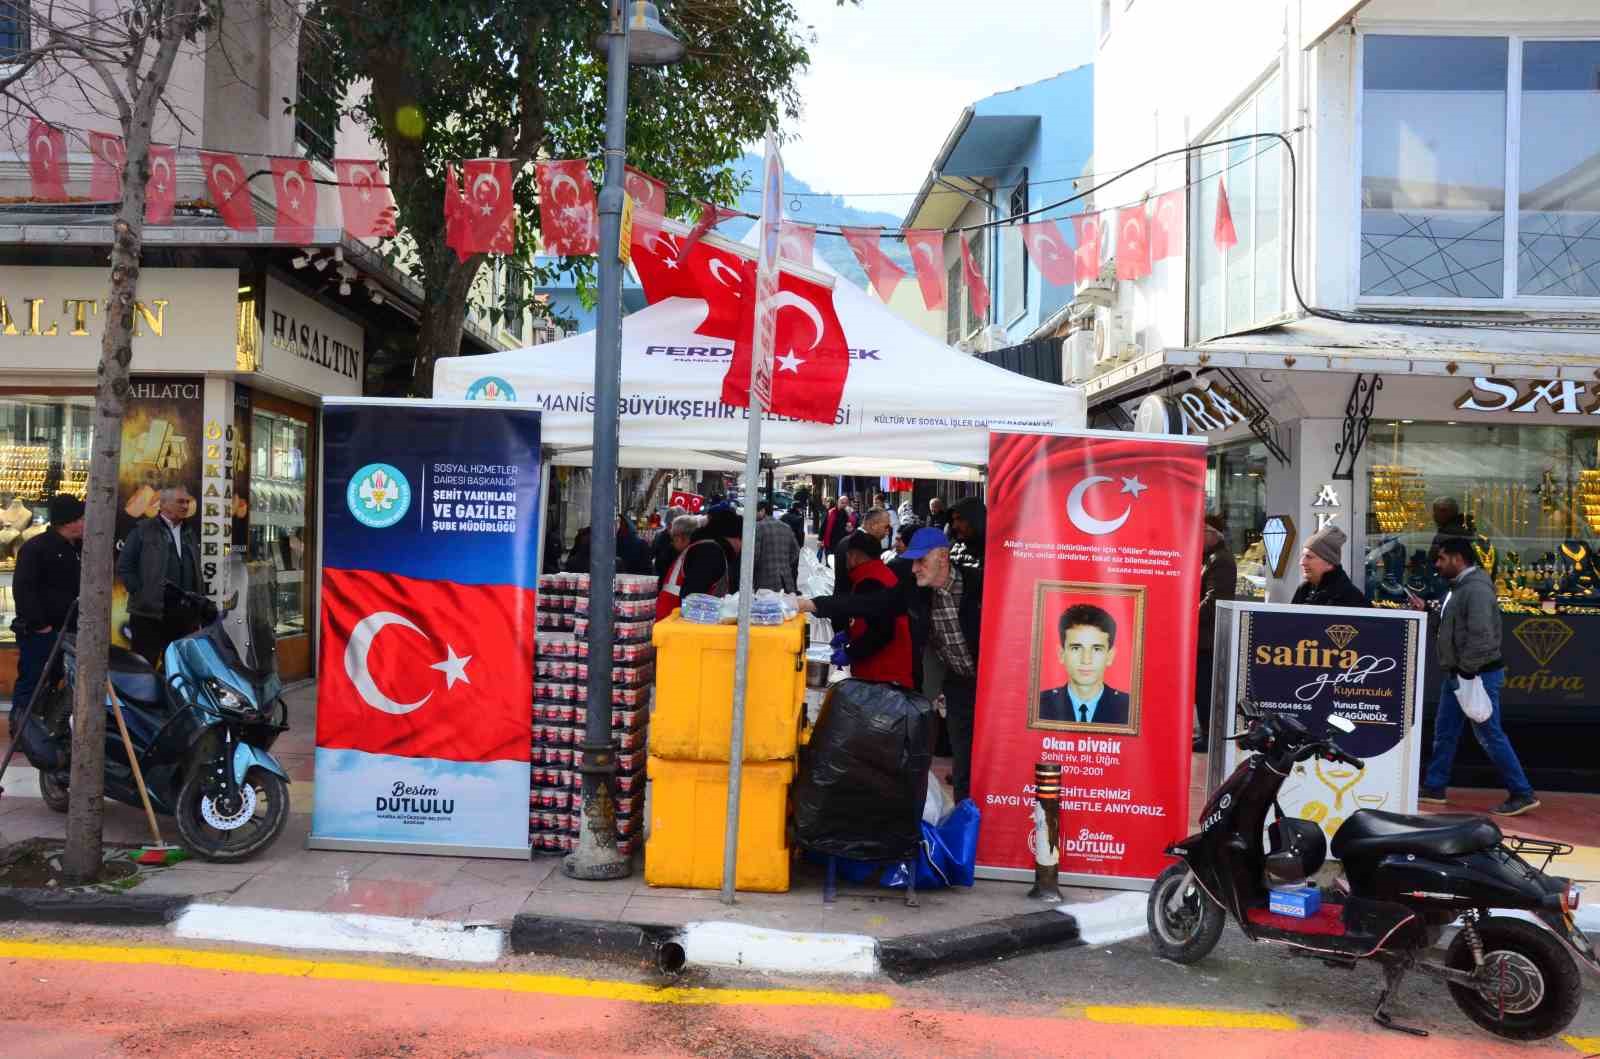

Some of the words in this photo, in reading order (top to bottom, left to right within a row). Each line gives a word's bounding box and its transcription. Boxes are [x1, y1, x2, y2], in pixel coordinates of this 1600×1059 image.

[272, 310, 360, 381] HASALTIN
[536, 392, 598, 413] MANİS
[873, 413, 904, 425] KÜLTÜR
[907, 417, 917, 425] VE
[918, 418, 948, 426] SOSYAL
[434, 463, 468, 474] SOSYAL
[470, 464, 519, 475] HİZMETLER
[433, 475, 466, 485] DAİRESİ
[467, 476, 516, 487] BAŞKANLIĞI
[433, 488, 462, 502] ŞEHİT
[464, 490, 517, 502] YAKINLARI
[432, 503, 452, 518] VE
[455, 501, 517, 520] GAZİLER
[432, 520, 457, 534] ŞUBE
[459, 520, 516, 533] MÜDÜRLÜĞÜ
[1256, 639, 1359, 669] safira
[1295, 655, 1397, 701] gold
[1333, 685, 1393, 698] Kuyumculuk
[1333, 701, 1357, 710] Yunus
[1358, 702, 1381, 710] Emre
[1042, 736, 1074, 751] Okan
[1078, 736, 1121, 754] DİVRİK
[1061, 765, 1103, 776] 1970-2001
[392, 780, 439, 797] Besim
[1059, 785, 1131, 801] EHİTLERİMİZİ
[376, 797, 455, 814] DUTLULU
[986, 794, 1020, 806] SAYGI
[1023, 797, 1038, 807] VE
[1104, 802, 1167, 817] ANIYORUZ.
[1078, 828, 1113, 841] Besim
[1066, 840, 1125, 855] DUTLULU
